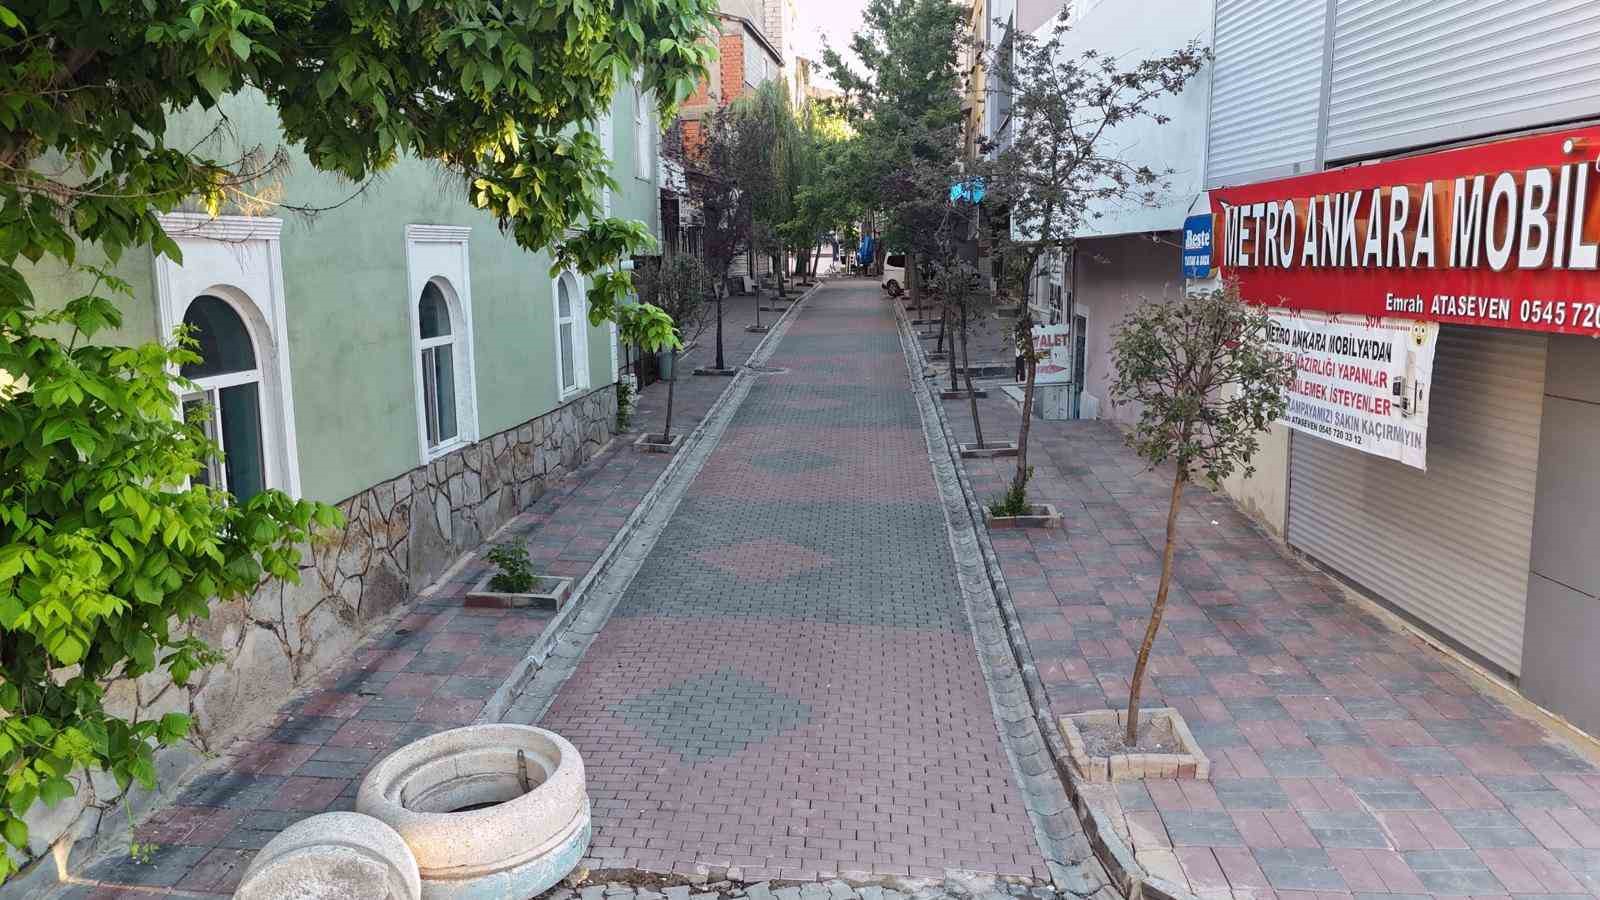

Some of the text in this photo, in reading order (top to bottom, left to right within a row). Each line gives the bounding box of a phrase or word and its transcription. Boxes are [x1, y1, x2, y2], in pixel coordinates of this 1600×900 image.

[1223, 138, 1600, 272] METRO ANKARA MOBİL
[1185, 229, 1210, 249] Beste
[1386, 292, 1424, 313] Emrah
[1430, 294, 1511, 321] ATASEVEN
[1520, 298, 1567, 326] 0545
[1291, 329, 1327, 353] ANKARA
[1327, 332, 1393, 363] MOBİLYA'DAN
[1337, 361, 1388, 389] YAPANLAR
[1282, 377, 1328, 400] ENİLEMEK
[1329, 383, 1392, 417] İSTEYENLER
[1291, 415, 1318, 432] ATASEVEN
[1333, 428, 1345, 440] 720
[1334, 410, 1361, 433] SAKIN
[1361, 418, 1423, 449] KAÇIRMAYIN
